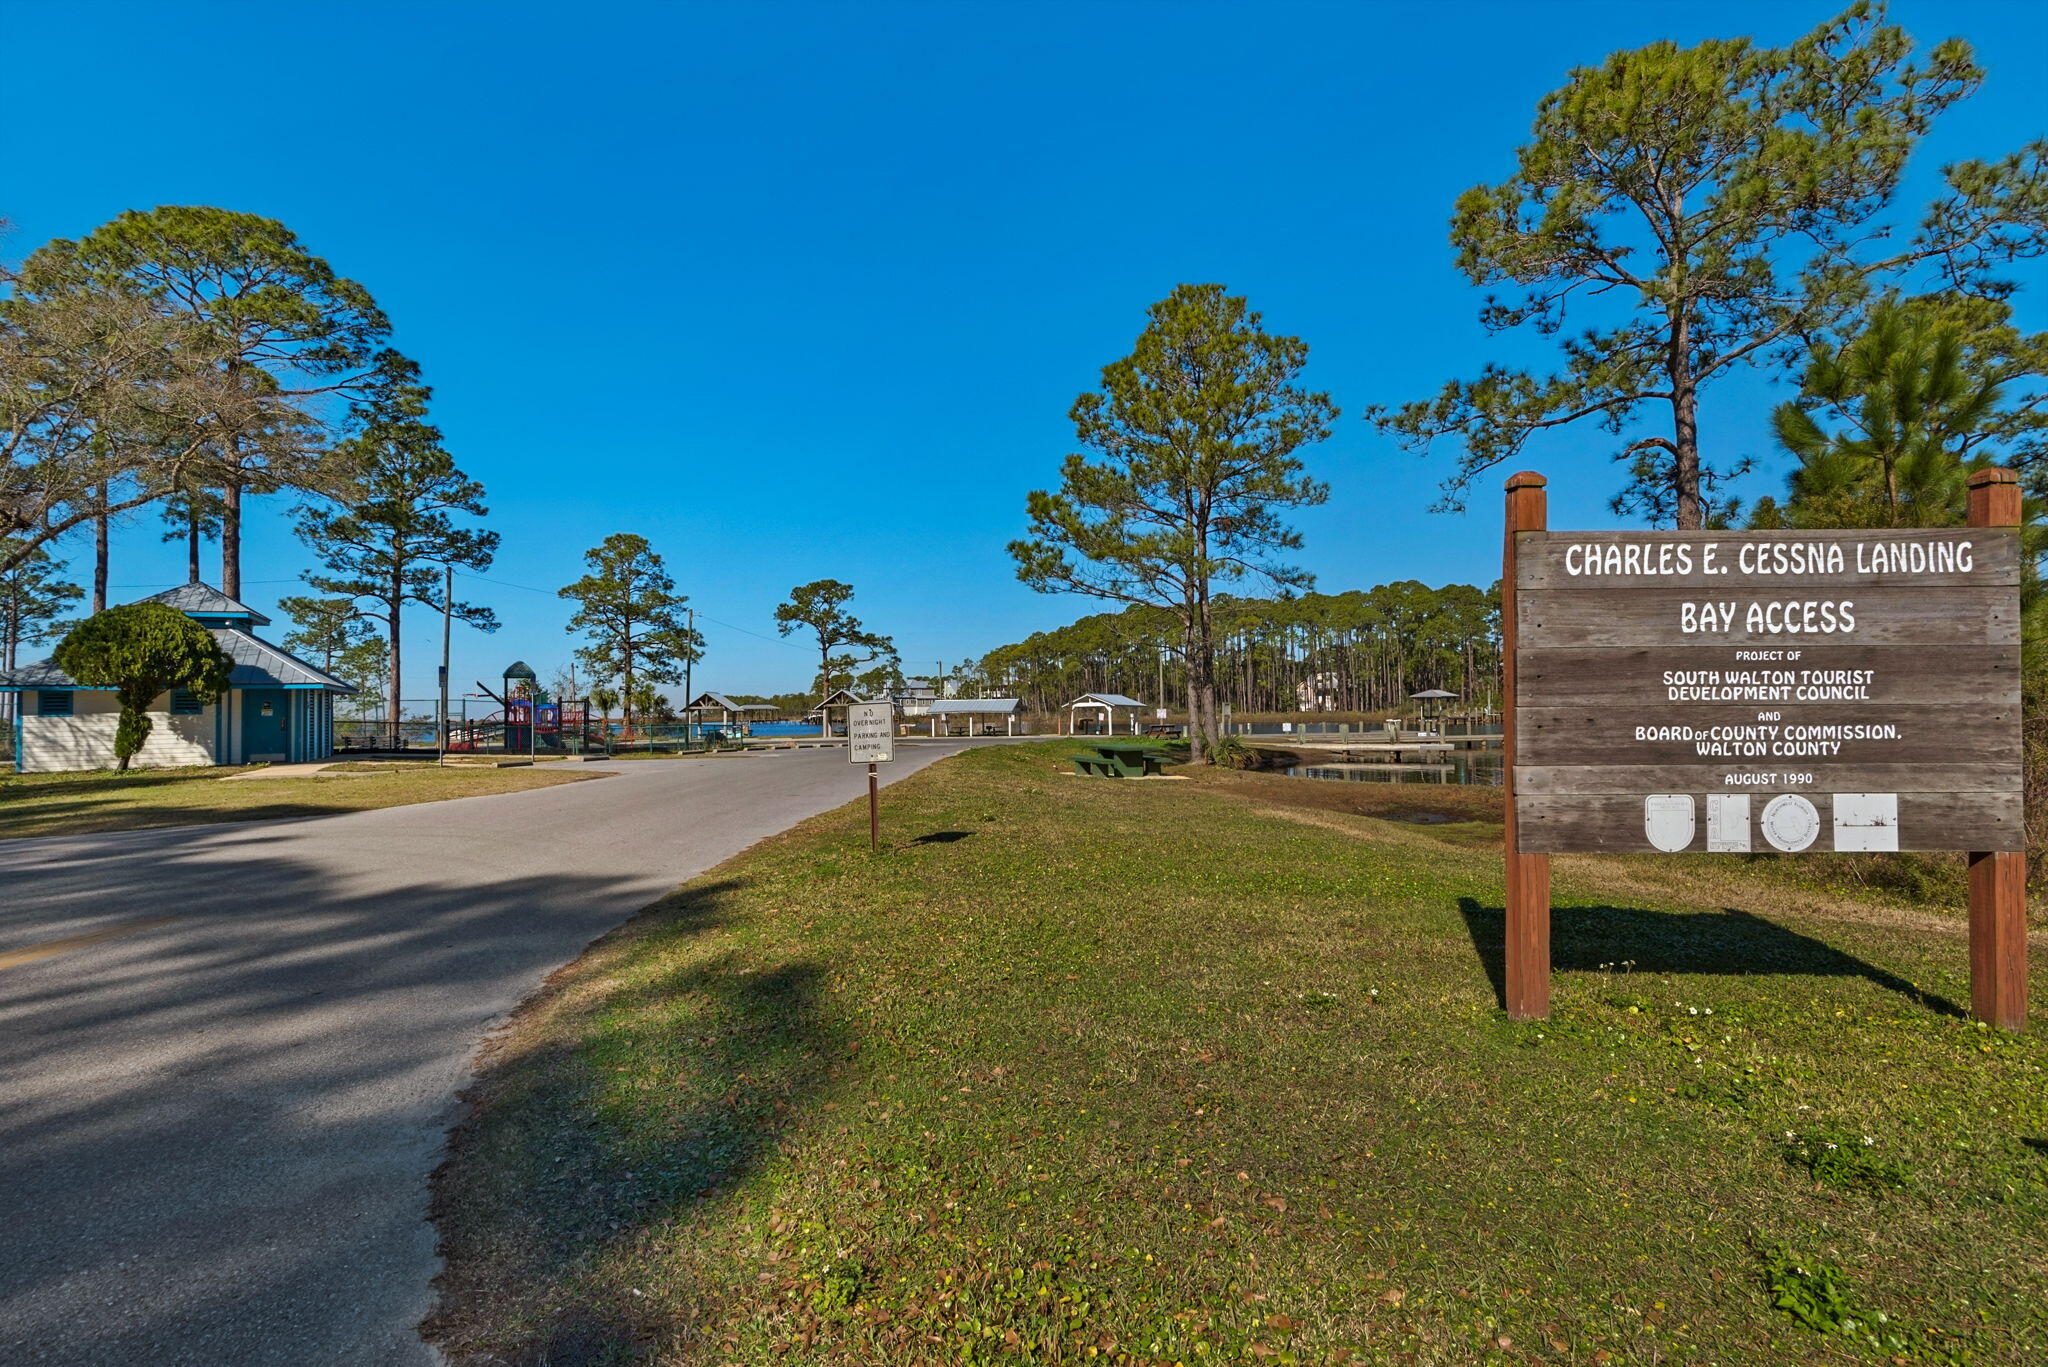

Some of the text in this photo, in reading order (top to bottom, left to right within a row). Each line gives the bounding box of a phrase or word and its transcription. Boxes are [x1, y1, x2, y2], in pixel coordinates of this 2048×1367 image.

[1565, 541, 1973, 576] CHARLES E. CESSNA LANDING
[1681, 601, 1855, 633] BAY ACCESS
[1735, 651, 1802, 661] PROJECT OF
[1663, 670, 1875, 686] SOUTH WALTON TOURIST
[1667, 686, 1870, 701] DEVELOPMENT COUNCIL
[853, 719, 886, 727] OVERNIGHT
[1757, 711, 1781, 722] AND
[1635, 724, 1902, 741] BOARD OF COUNTY COMMISSION.
[854, 743, 881, 751] CAMPING
[1695, 741, 1842, 756] WALTON COUNTY
[1724, 773, 1813, 785] AUGUST 1990
